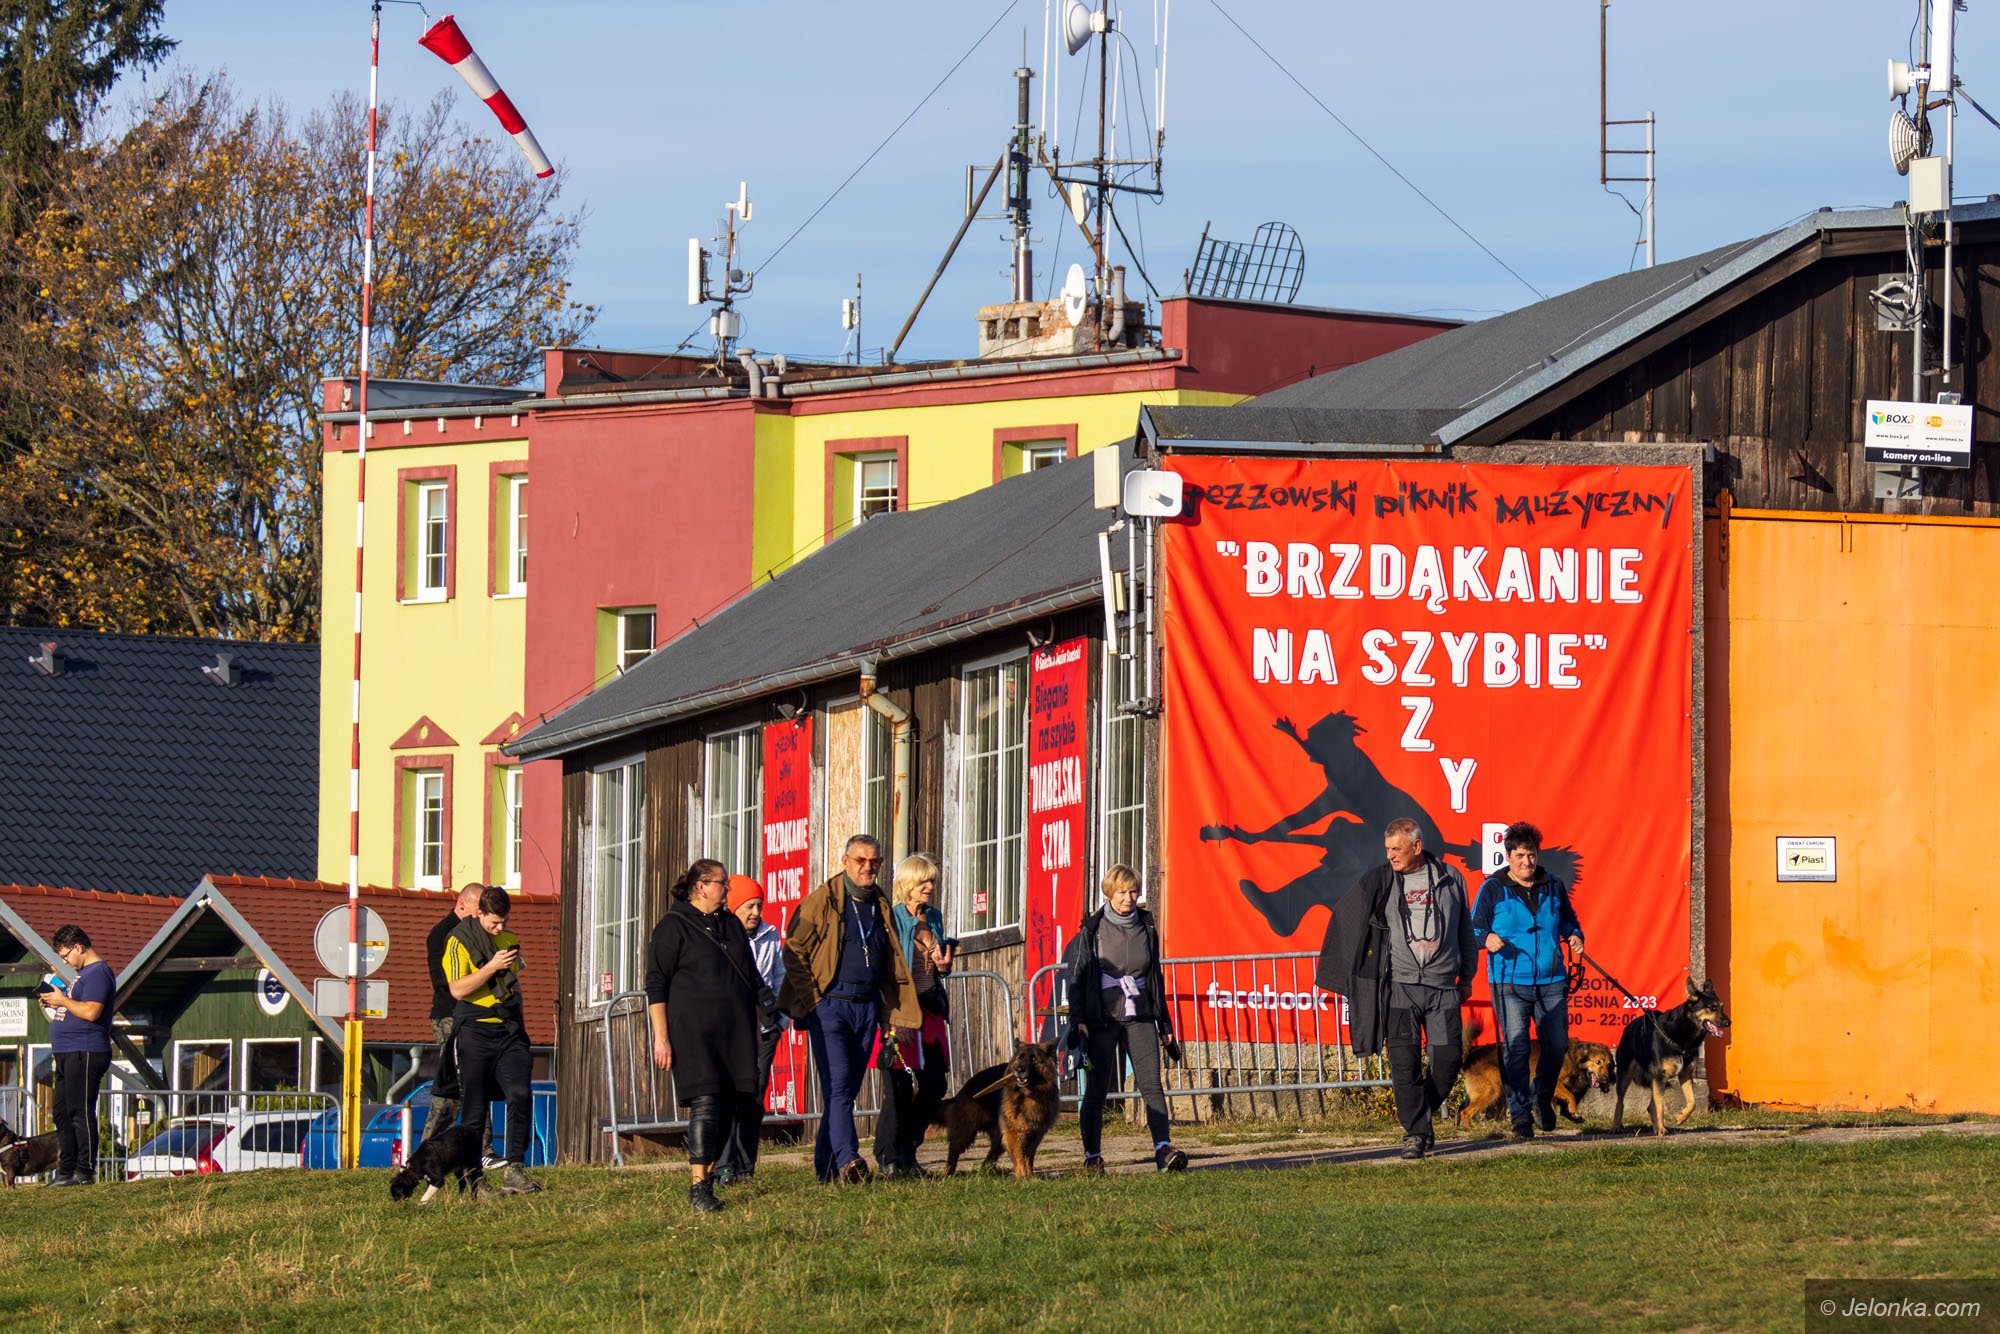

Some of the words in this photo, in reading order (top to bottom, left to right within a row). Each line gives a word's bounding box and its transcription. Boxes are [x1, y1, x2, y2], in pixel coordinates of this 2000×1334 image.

[1883, 450, 1918, 462] kamery
[1919, 453, 1952, 463] on-line
[1253, 628, 1339, 685] NA
[1361, 629, 1608, 689] SZYBIE"
[1035, 673, 1069, 721] Bieganie
[1039, 726, 1050, 752] na
[1050, 712, 1076, 757] szybie
[1400, 696, 1435, 752] Z
[1439, 757, 1478, 813] Y
[1041, 819, 1071, 871] SZYBA
[1482, 823, 1511, 875] B
[1801, 856, 1825, 864] Piast
[1206, 981, 1329, 1011] facebook
[1623, 996, 1657, 1009] 2023
